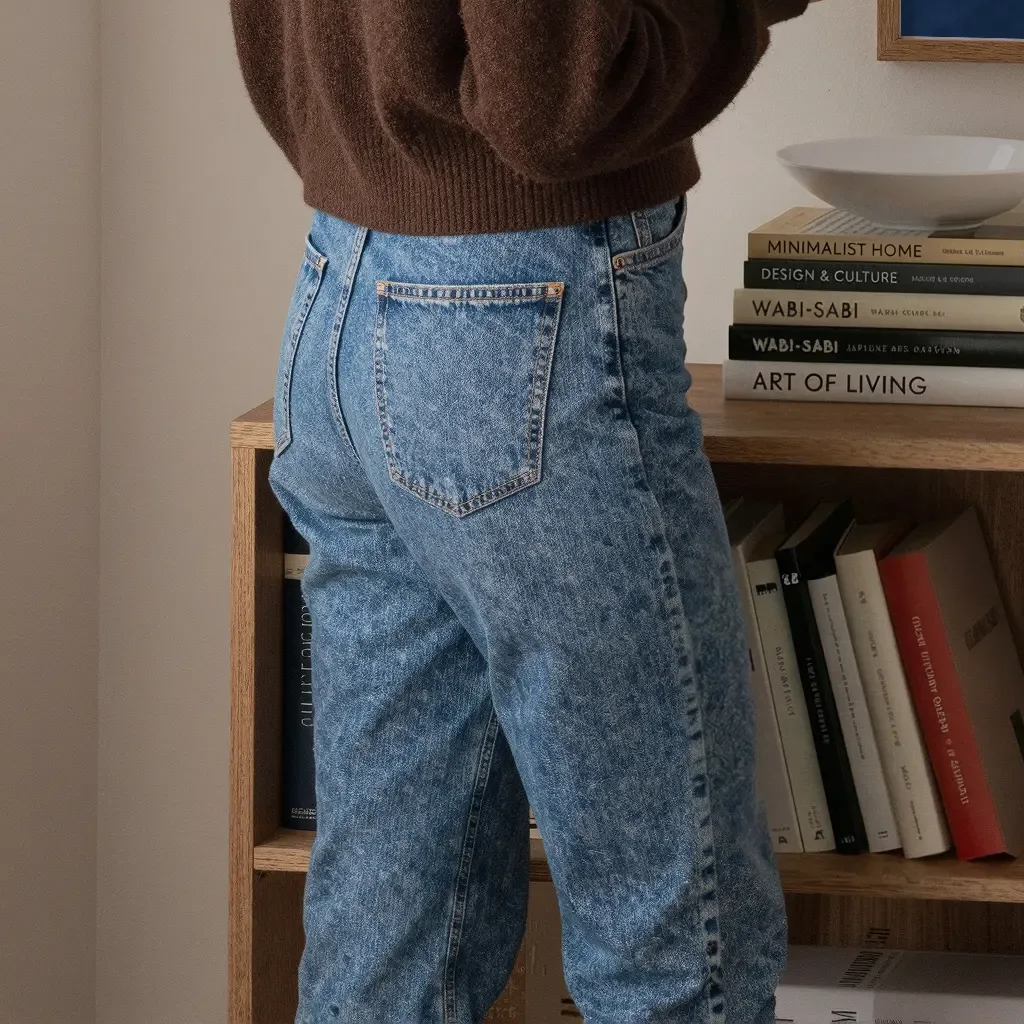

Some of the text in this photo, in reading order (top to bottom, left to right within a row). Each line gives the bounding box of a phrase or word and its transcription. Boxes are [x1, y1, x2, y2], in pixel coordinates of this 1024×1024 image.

[767, 240, 921, 257] MINIMALIST HOME
[762, 268, 814, 280] DESIGN
[820, 270, 829, 281] &
[834, 270, 897, 283] CULTURE
[752, 300, 857, 318] WABI-SABI
[753, 338, 837, 353] WABI-SABI
[753, 372, 926, 394] ART OF LIVING
